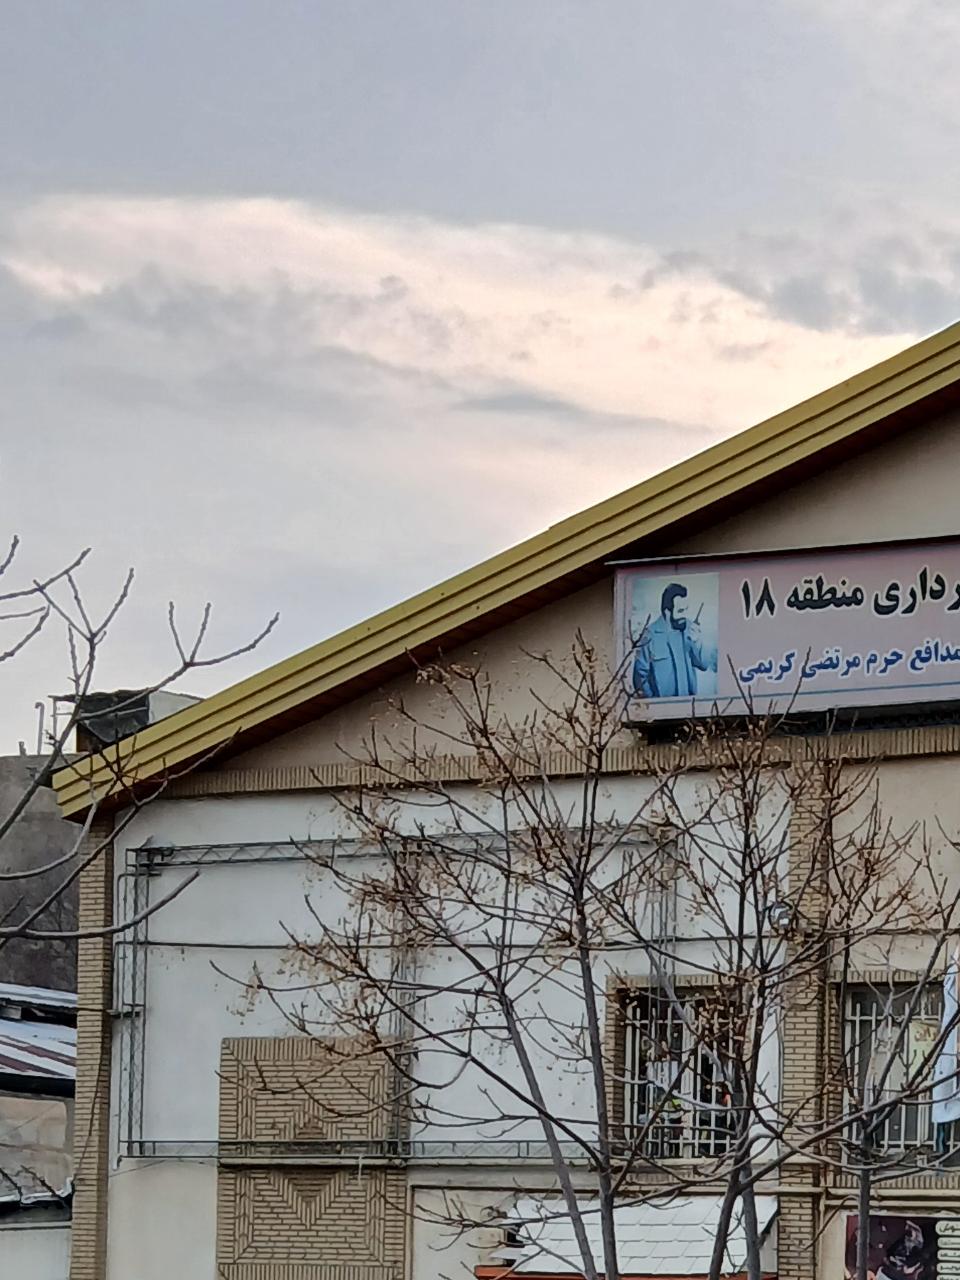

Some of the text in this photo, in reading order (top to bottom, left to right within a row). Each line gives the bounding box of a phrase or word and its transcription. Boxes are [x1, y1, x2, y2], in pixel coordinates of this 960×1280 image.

[741, 578, 776, 618] ۱۸
[786, 576, 864, 611] منطقه
[738, 652, 796, 683] کریمی
[800, 648, 861, 678] مرتضی
[866, 649, 903, 674] حرم
